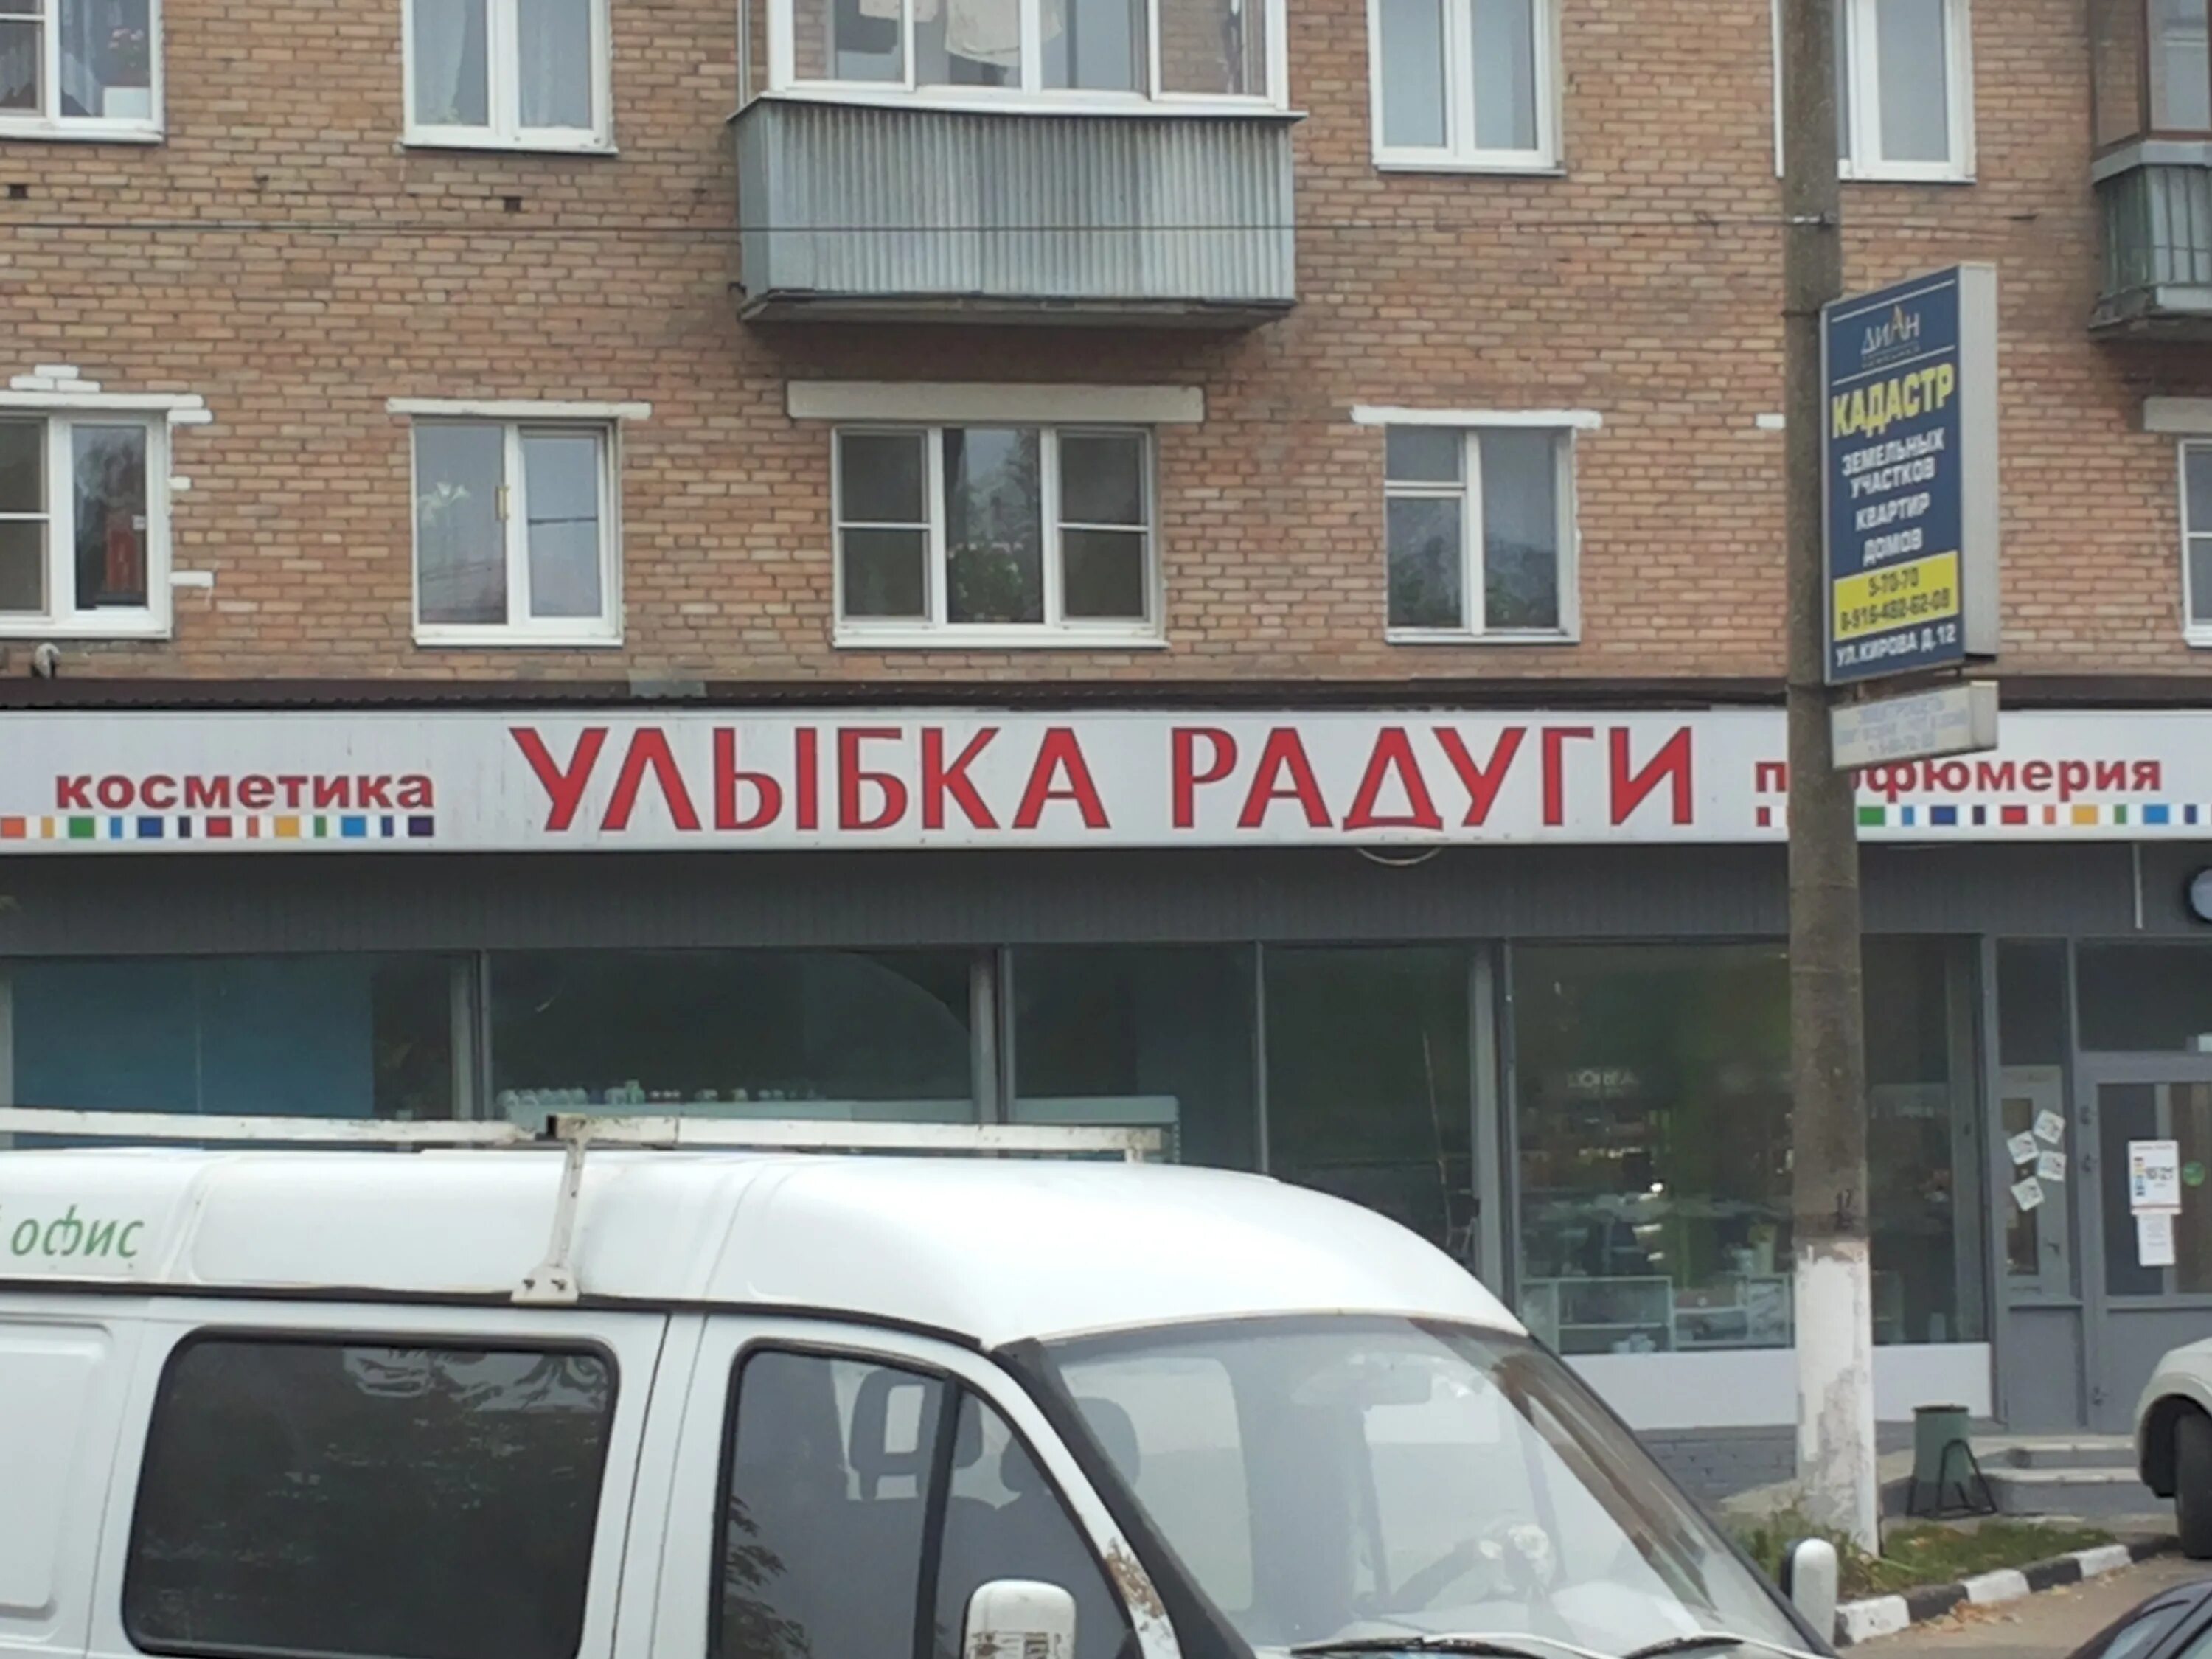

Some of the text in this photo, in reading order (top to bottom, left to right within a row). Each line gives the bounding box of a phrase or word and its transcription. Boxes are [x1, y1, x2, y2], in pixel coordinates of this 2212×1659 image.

[1832, 363, 1954, 439] КАДАСТР
[1842, 428, 1944, 476] ЗЕМЕЛЬНЫХ
[1851, 456, 1935, 498] УЧАСТКОВ
[1856, 492, 1930, 532] КВАРТИР
[1863, 527, 1922, 567] ДОМОВ
[55, 773, 434, 809] косметика
[509, 727, 1694, 831] УЛЫБКА РАДУГИ
[1755, 759, 2161, 802] пфюмерия
[11, 1203, 145, 1259] офис
